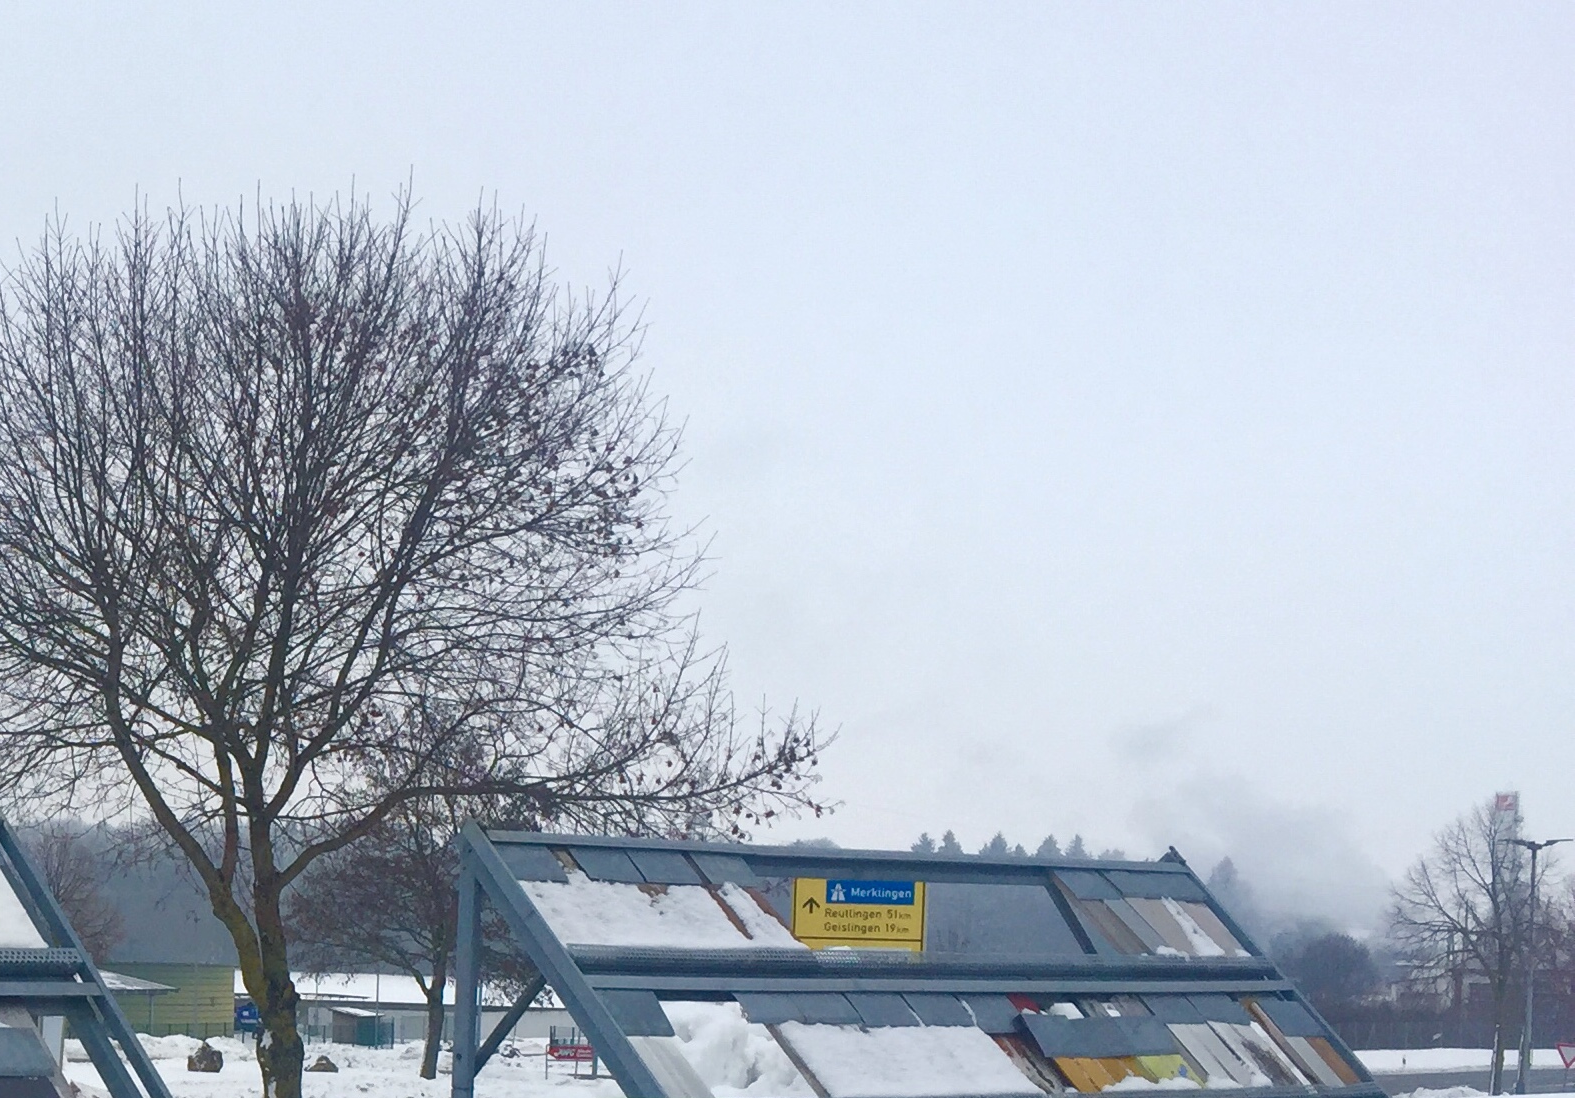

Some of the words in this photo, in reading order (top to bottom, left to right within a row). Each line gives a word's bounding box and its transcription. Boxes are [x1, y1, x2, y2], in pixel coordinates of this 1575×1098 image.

[851, 887, 912, 900] Merklingen
[824, 908, 882, 921] Reutlingen
[823, 922, 881, 934] Geislingen
